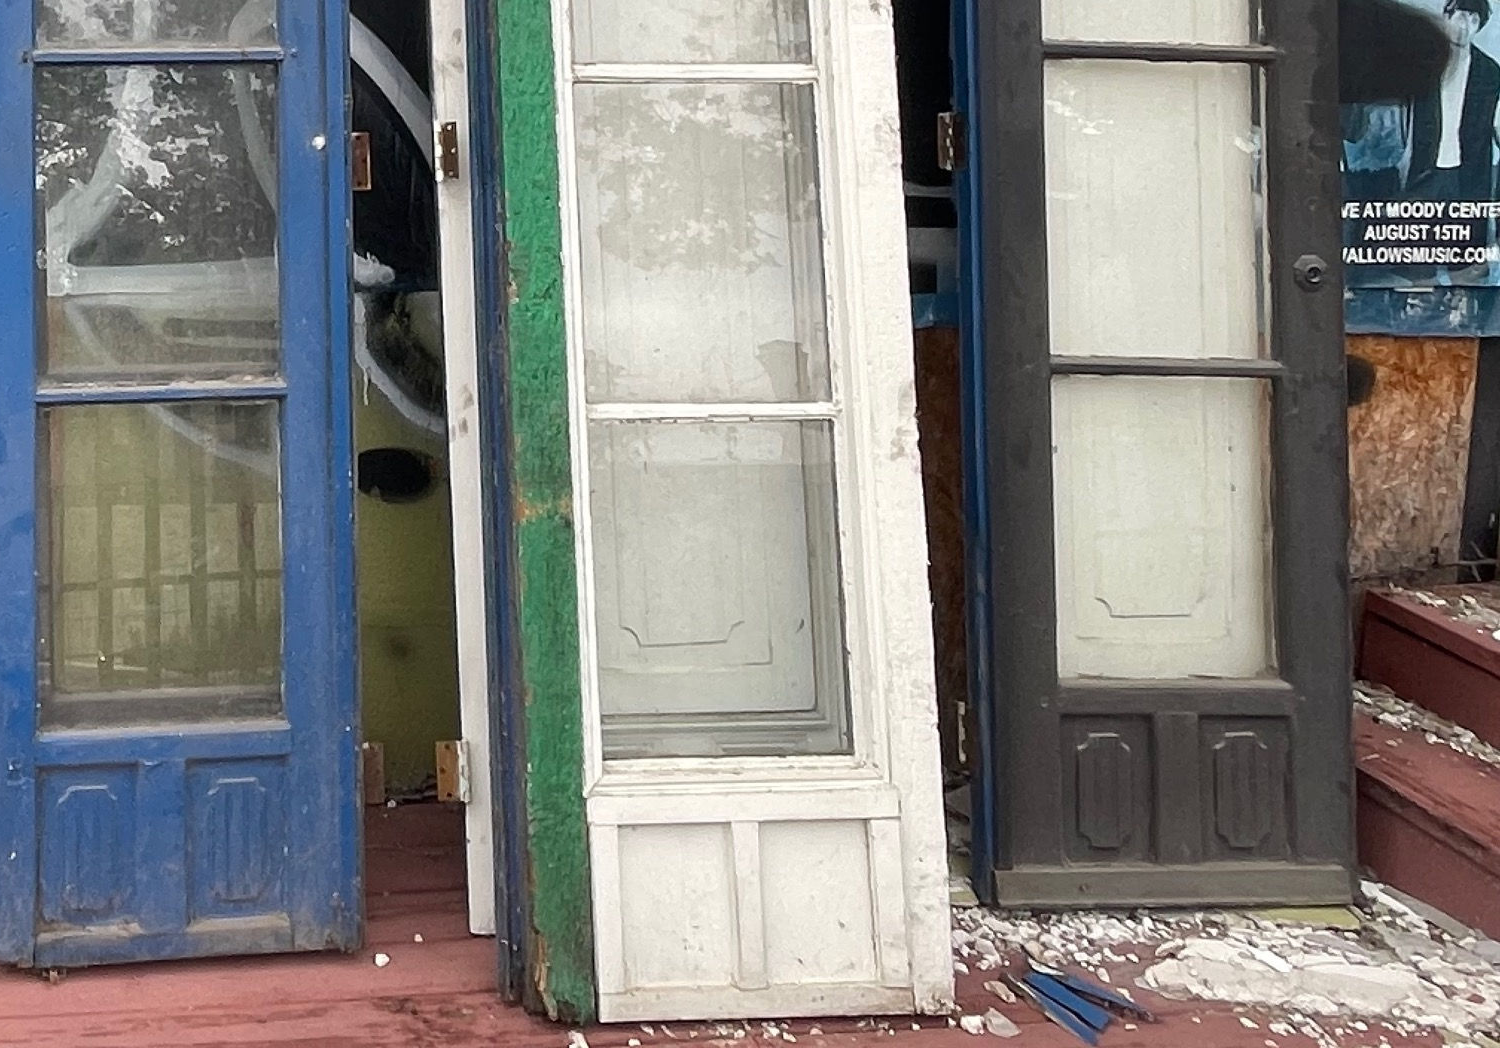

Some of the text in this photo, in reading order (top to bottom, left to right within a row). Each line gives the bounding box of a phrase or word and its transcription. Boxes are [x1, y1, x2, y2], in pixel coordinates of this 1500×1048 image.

[1362, 202, 1384, 219] AT
[1386, 202, 1446, 219] MOODY
[1449, 202, 1500, 219] CENTE
[1363, 224, 1471, 241] AUGUST 15TH
